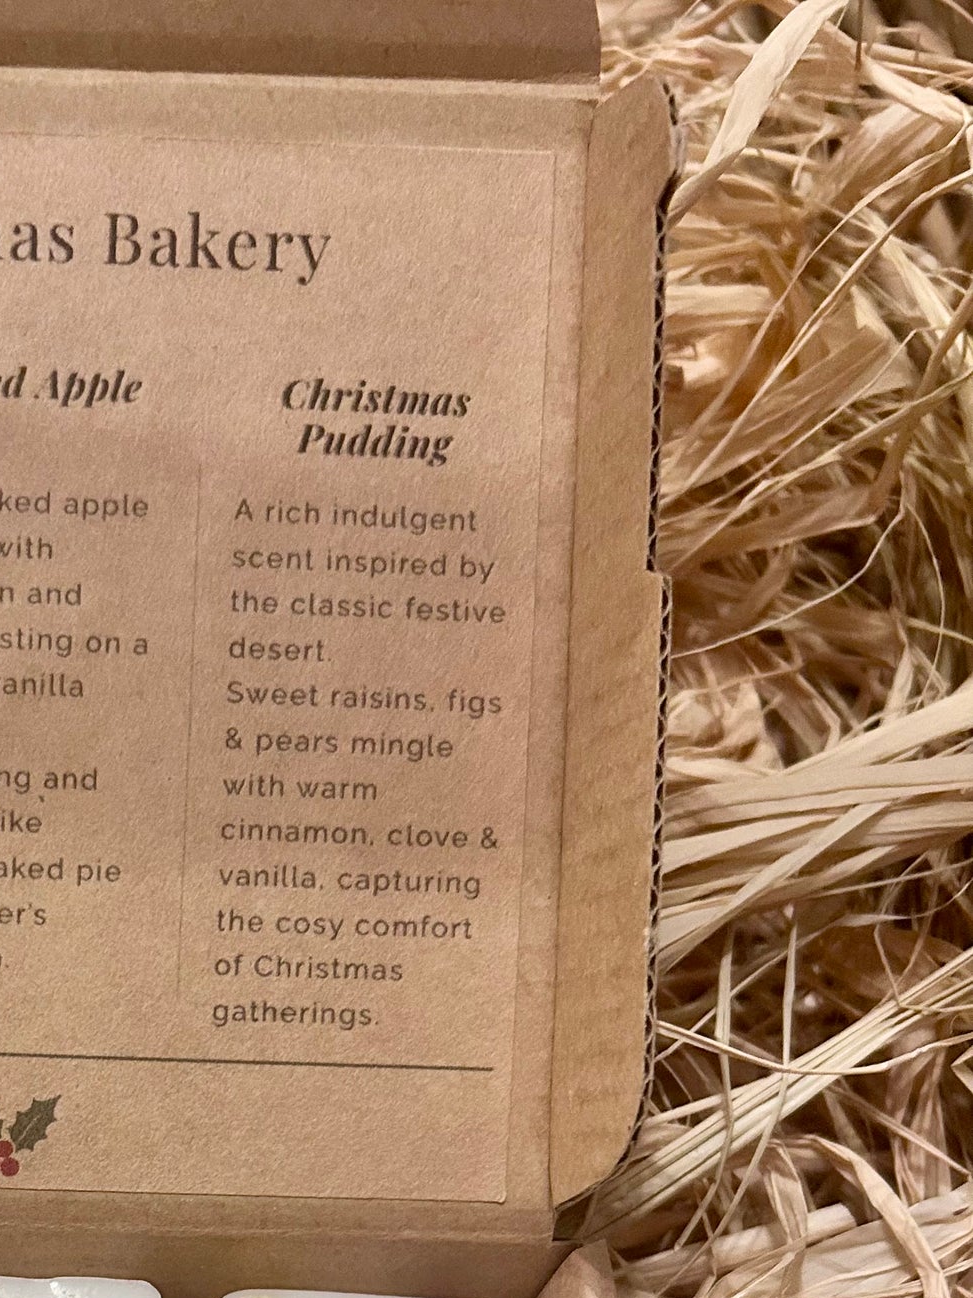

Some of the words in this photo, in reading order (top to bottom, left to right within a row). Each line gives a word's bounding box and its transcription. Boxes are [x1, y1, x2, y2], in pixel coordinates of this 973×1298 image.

[104, 211, 331, 287] Bakery
[36, 369, 143, 408] Apple
[281, 378, 471, 417] Christmas
[297, 424, 453, 467] Pudding
[63, 494, 149, 521] apple
[234, 498, 253, 522] A
[265, 500, 320, 524] rich
[333, 498, 476, 535] indulgent
[232, 549, 313, 571] scent
[327, 549, 447, 578] inspired
[460, 554, 494, 584] by
[27, 583, 82, 606] and
[231, 590, 278, 613] the
[290, 593, 392, 619] classic
[406, 596, 506, 623] festive
[85, 634, 120, 654] on
[133, 637, 148, 655] a
[227, 636, 332, 662] desert.
[227, 680, 318, 707] Sweet
[331, 685, 435, 713] raisins,
[447, 688, 502, 719] figs
[225, 727, 242, 750] &
[256, 732, 338, 756] pears
[351, 734, 454, 763] mingle
[43, 768, 98, 791] and
[223, 774, 284, 798] with
[297, 781, 377, 800] warm
[220, 818, 374, 846] cinnamon,
[387, 824, 468, 848] clove
[480, 826, 498, 850] &
[77, 863, 121, 886] pie
[219, 864, 324, 891] vanilla,
[337, 871, 481, 900] capturing
[217, 908, 263, 933] the
[275, 916, 344, 941] cosy
[355, 915, 472, 939] comfort
[214, 953, 244, 977] of
[254, 954, 403, 981] Christmas
[212, 1000, 379, 1031] gatherings.
